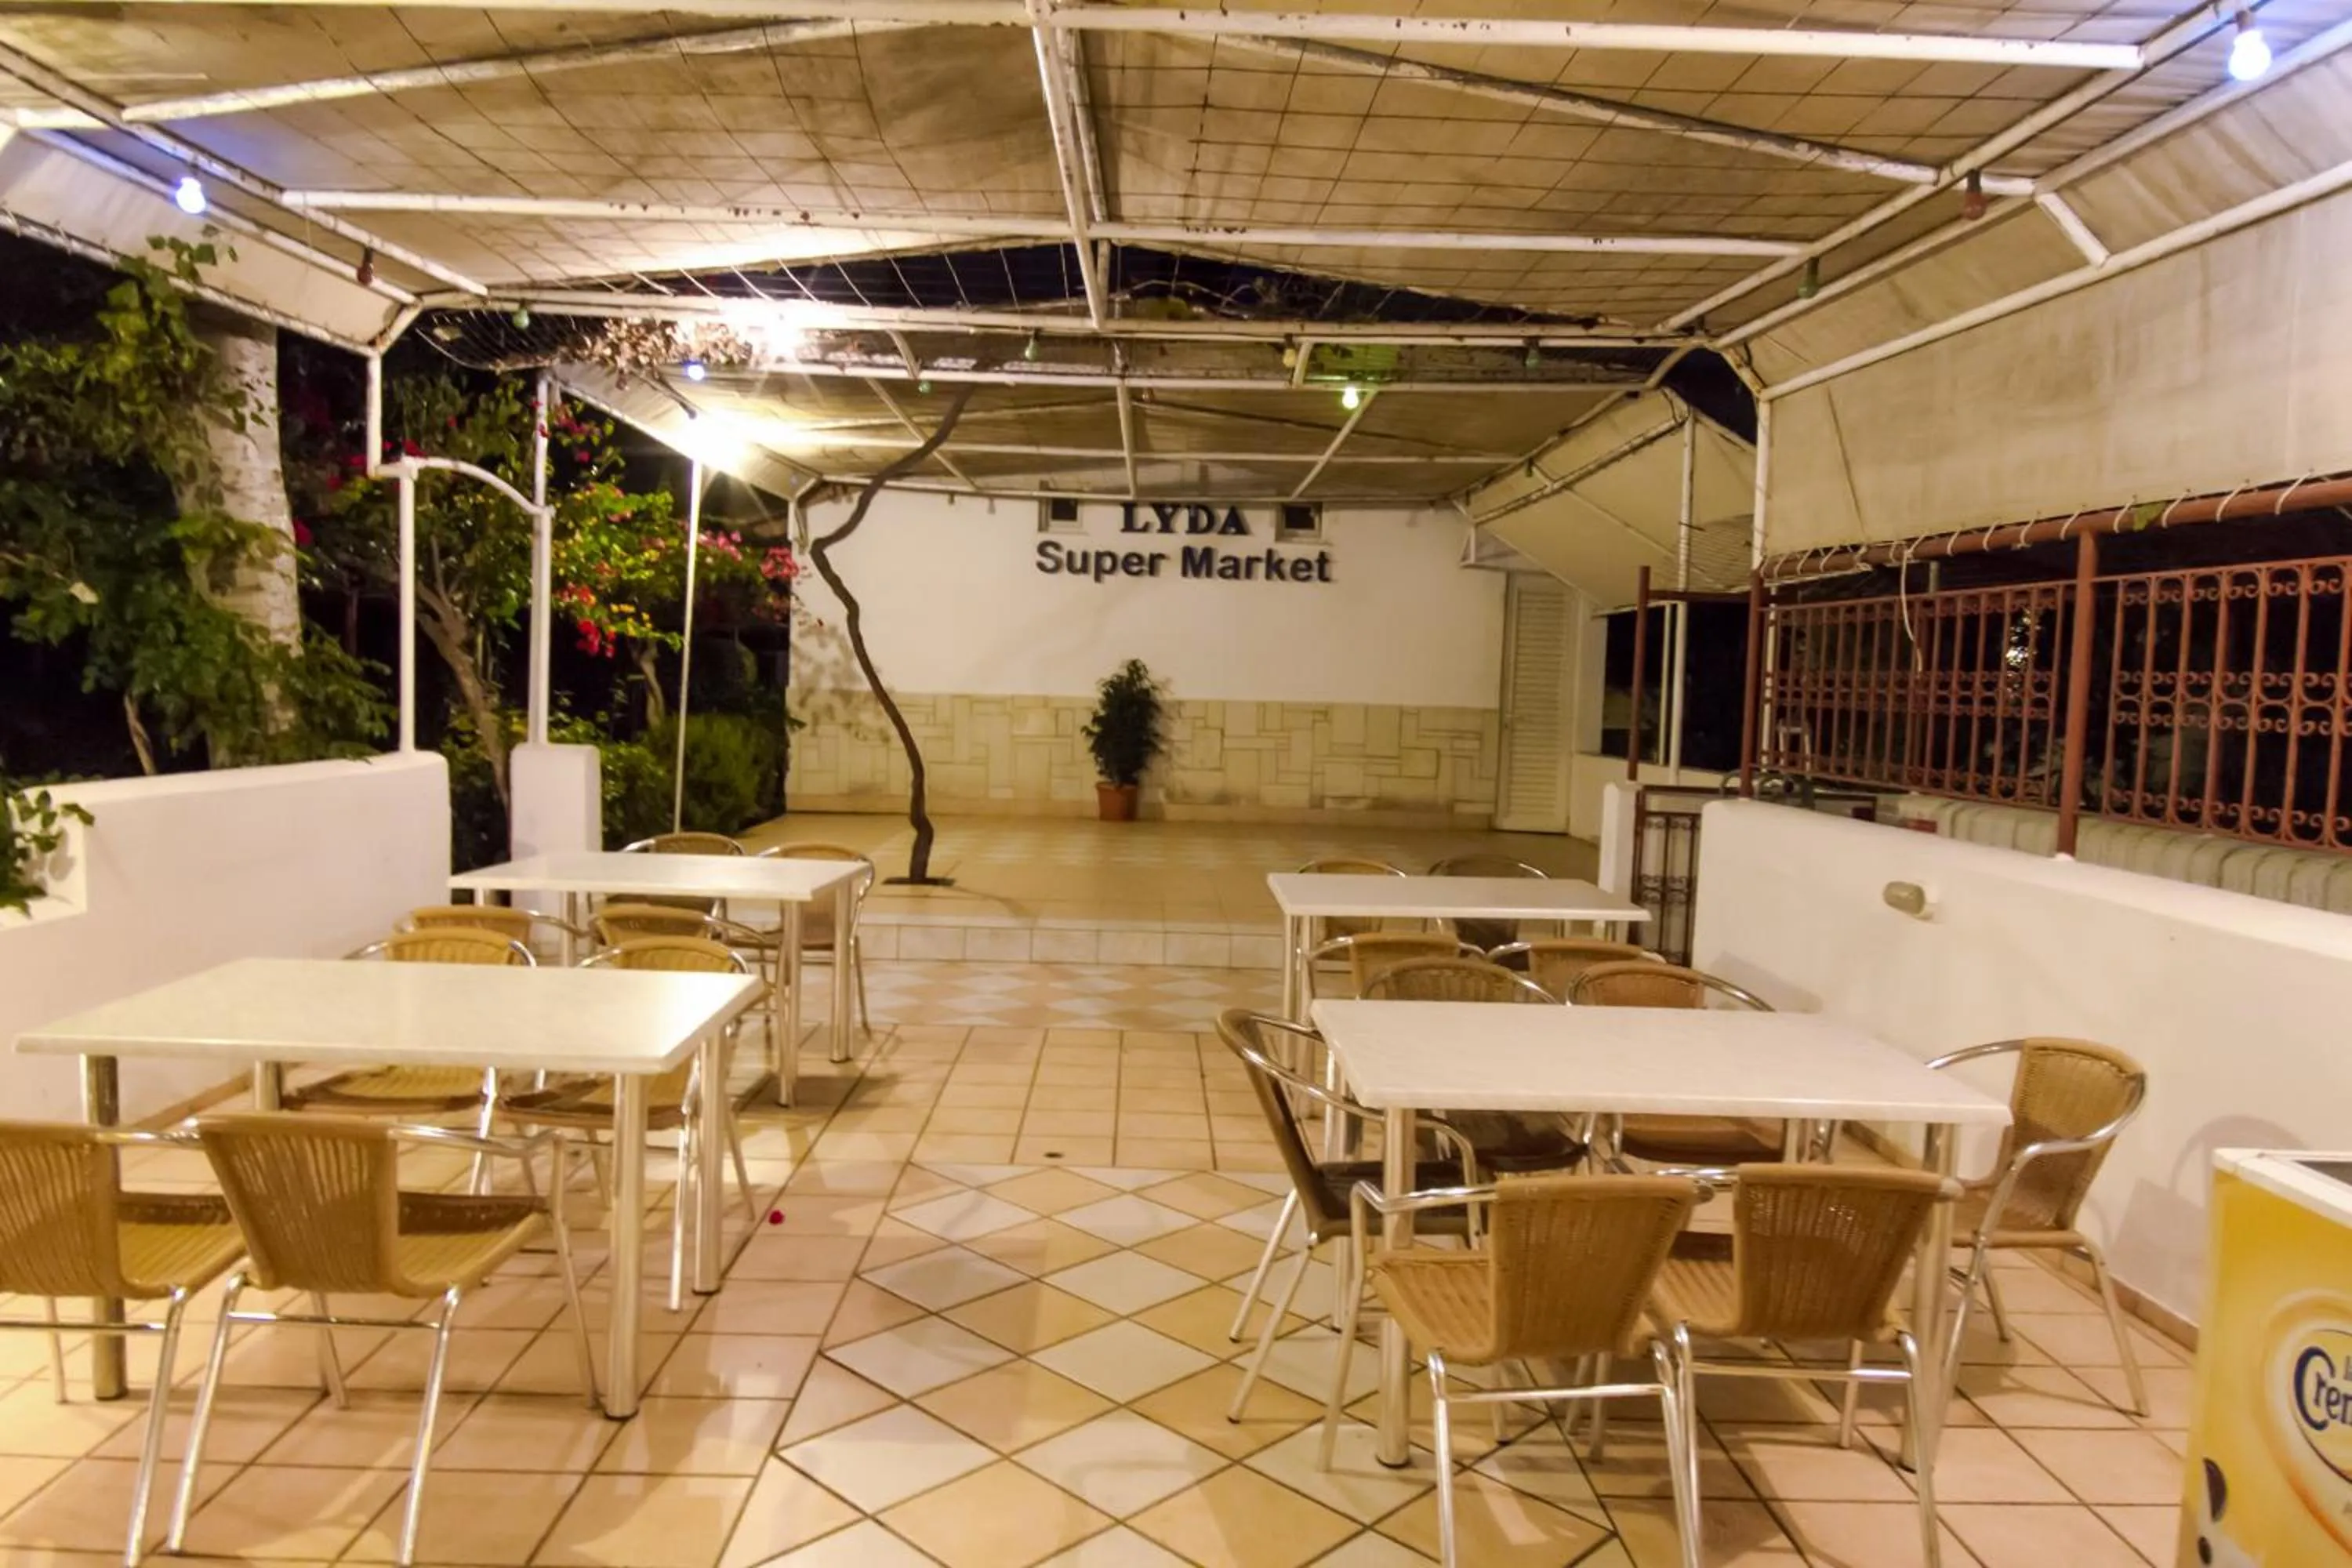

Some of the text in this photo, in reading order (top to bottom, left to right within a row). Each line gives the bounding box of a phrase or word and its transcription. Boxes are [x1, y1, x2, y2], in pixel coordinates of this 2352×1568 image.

[1120, 502, 1250, 535] LYDA
[1036, 540, 1333, 583] Super Market
